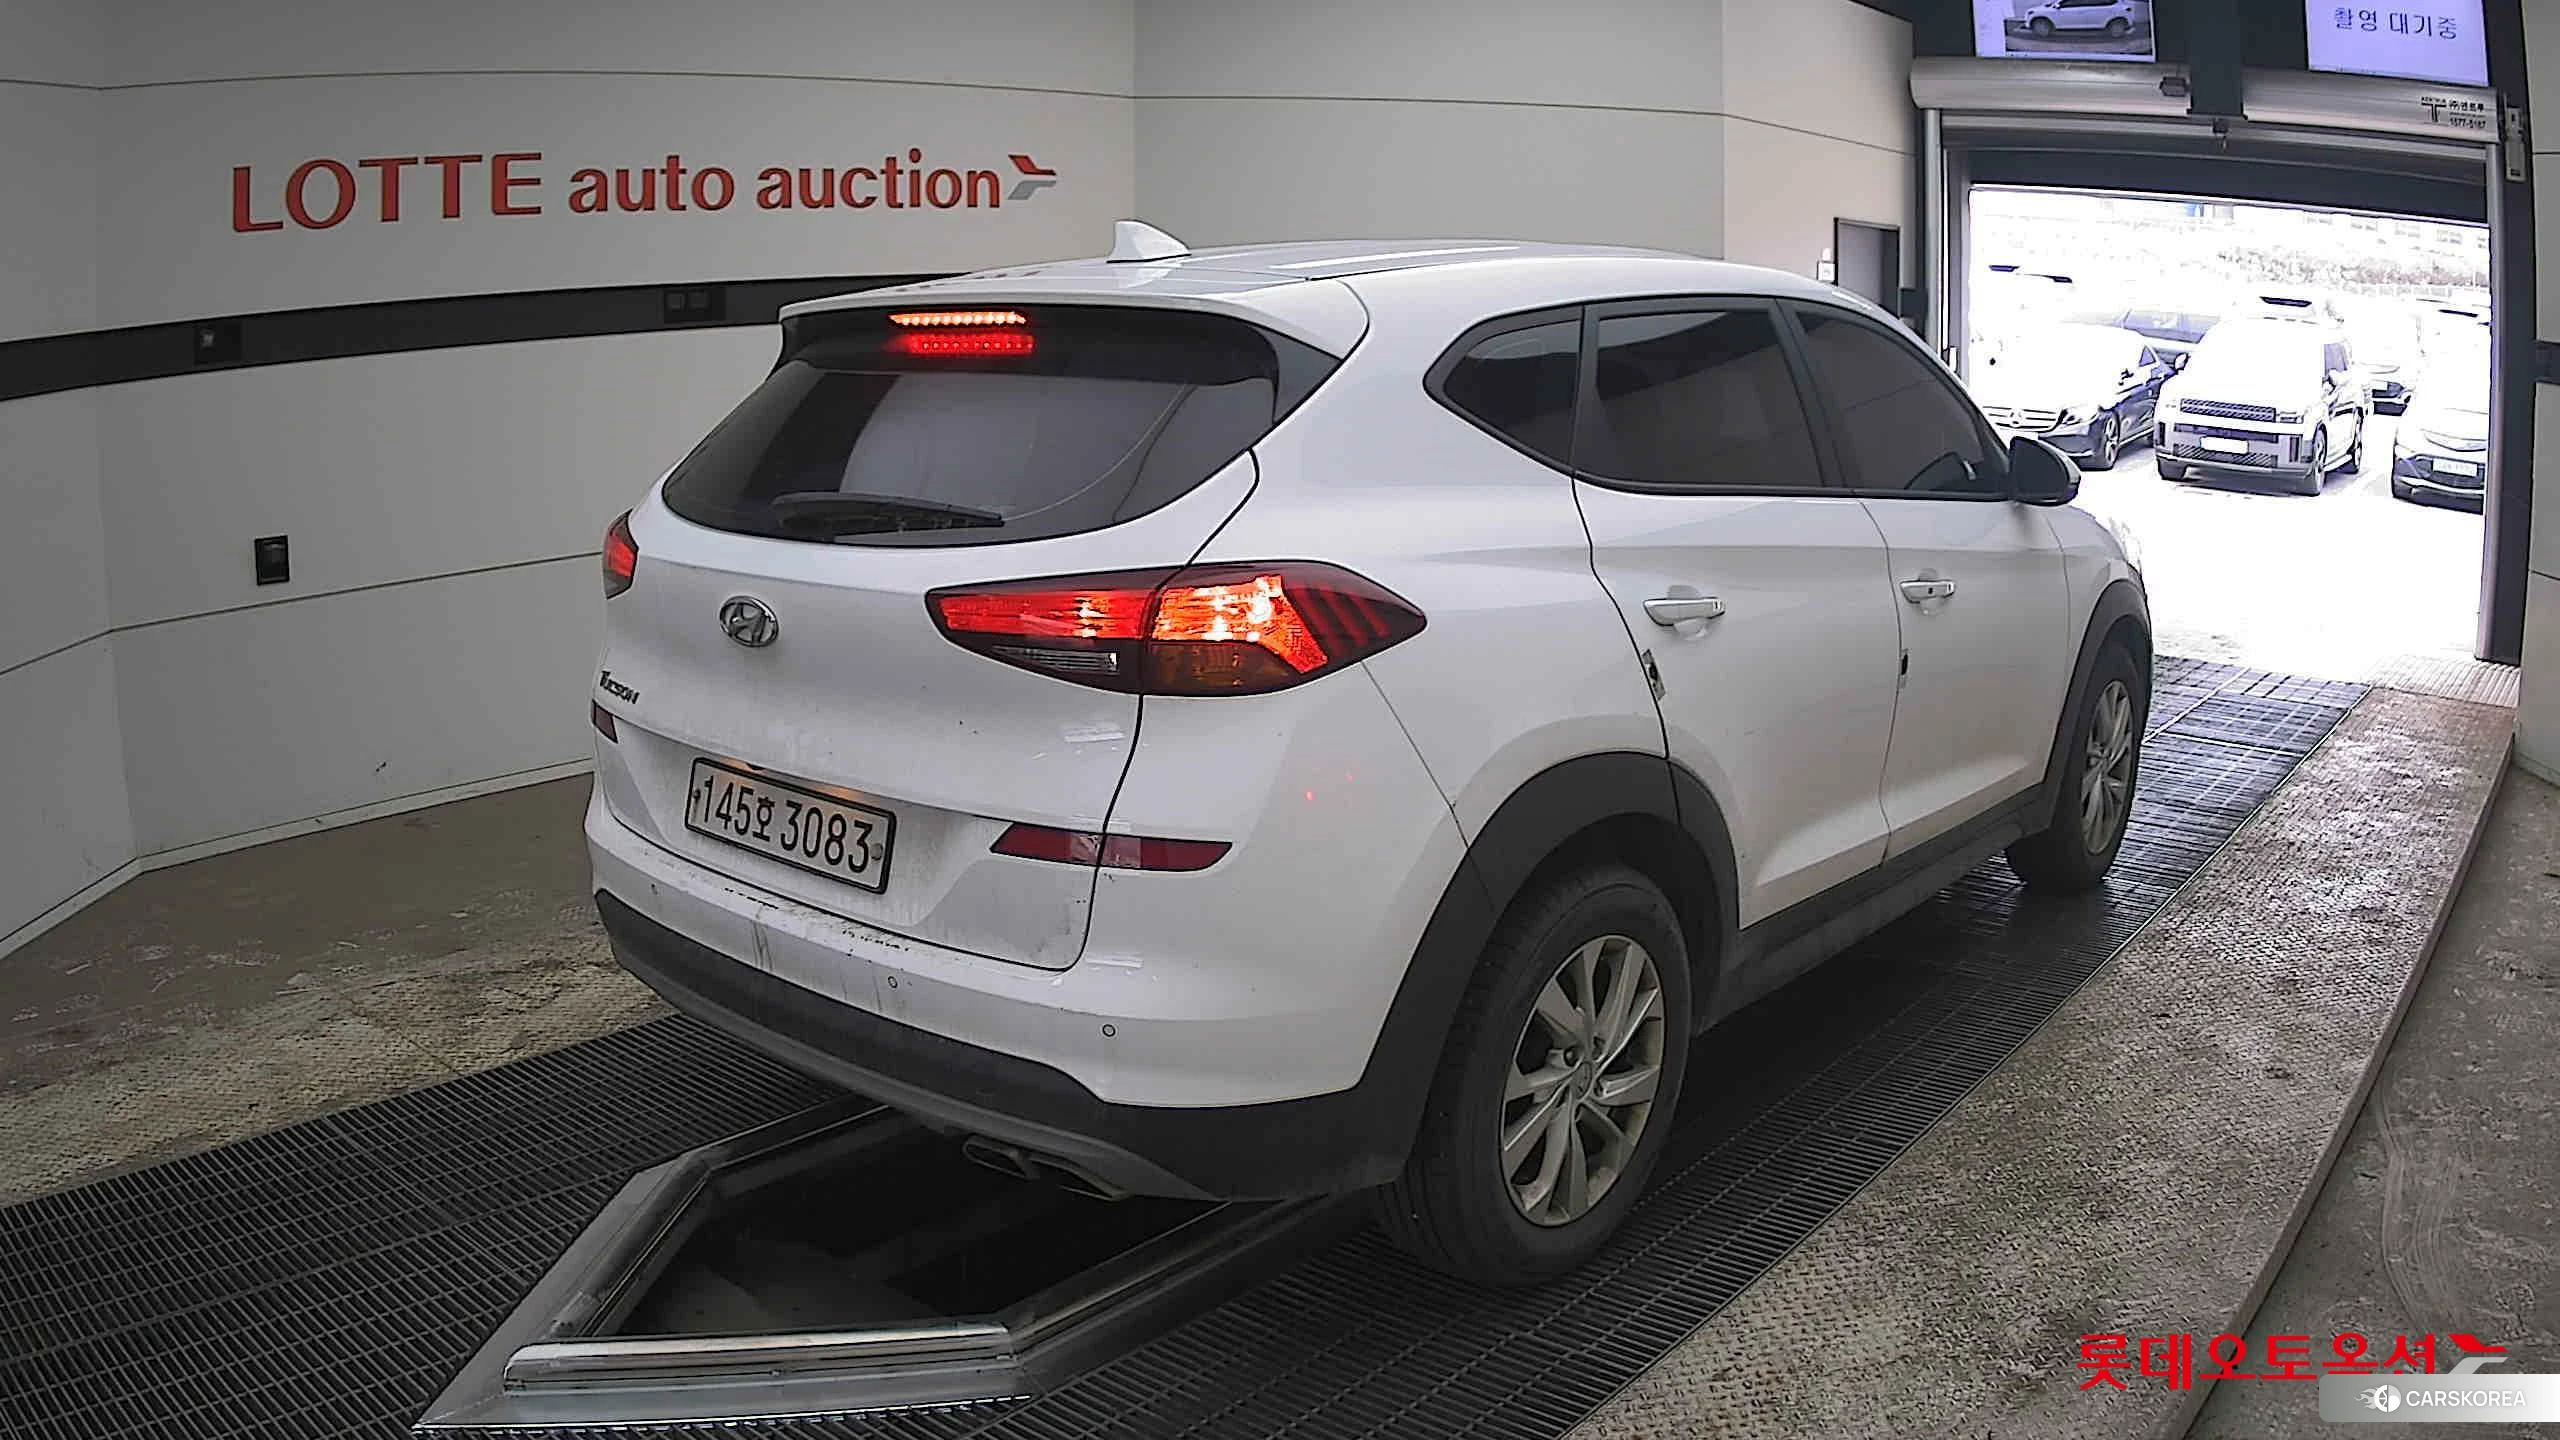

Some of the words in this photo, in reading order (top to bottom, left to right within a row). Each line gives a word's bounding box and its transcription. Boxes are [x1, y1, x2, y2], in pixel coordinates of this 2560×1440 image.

[2335, 7, 2377, 32] 촬영
[2389, 12, 2457, 40] 대기중
[232, 152, 543, 233] LOTTE
[568, 154, 735, 213] auto
[756, 147, 1001, 209] auction
[780, 799, 873, 874] 3083
